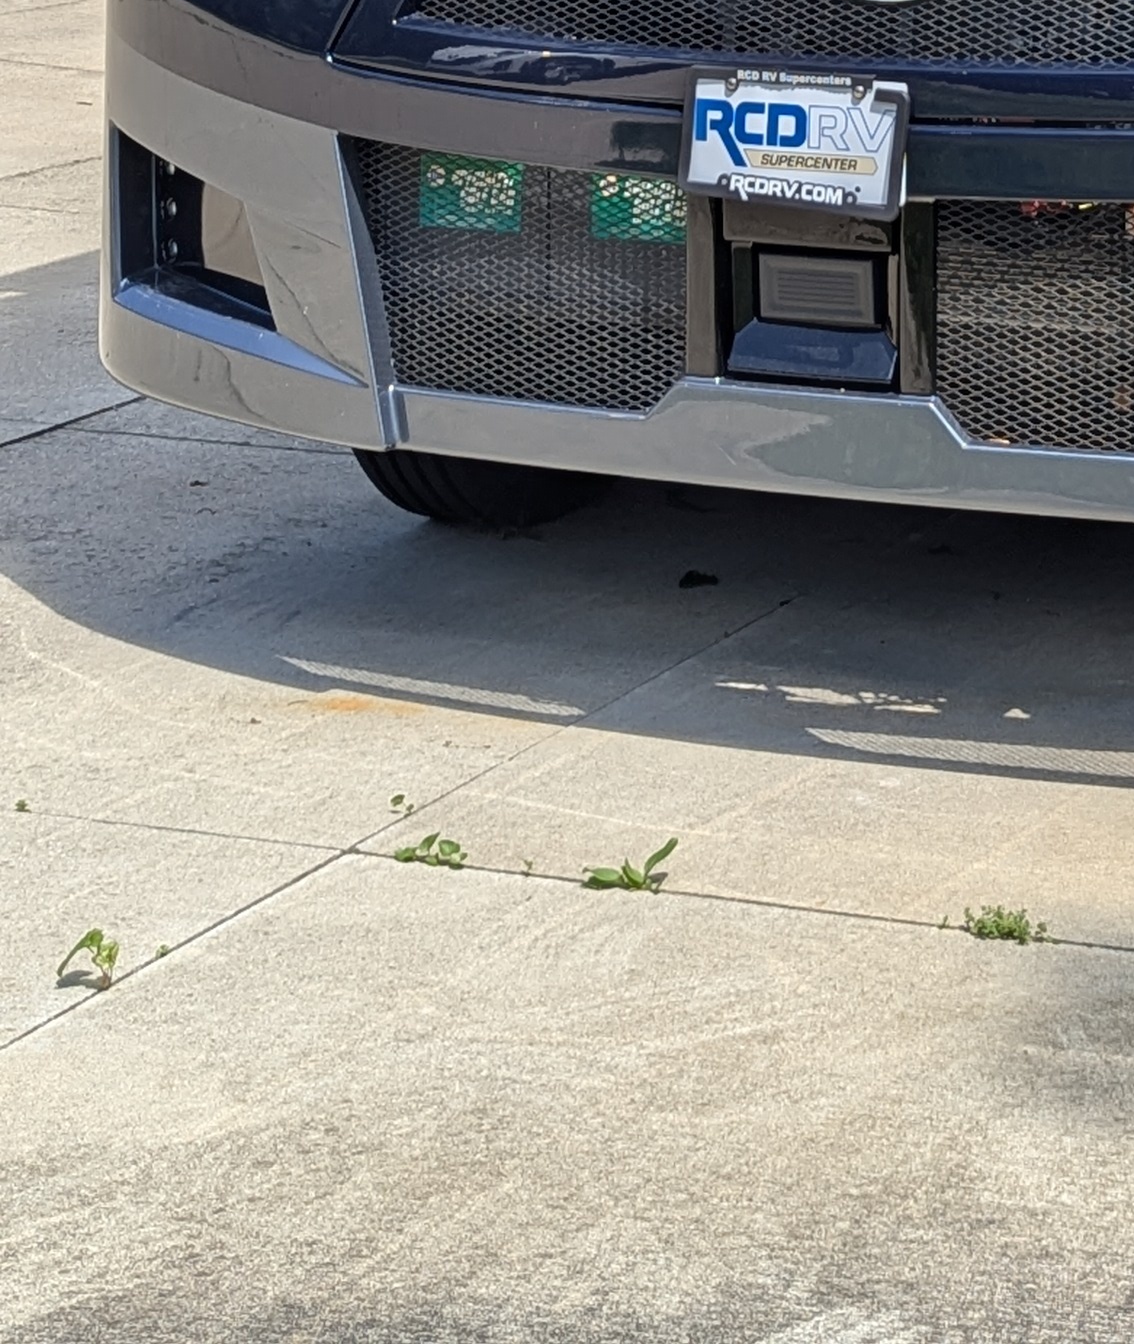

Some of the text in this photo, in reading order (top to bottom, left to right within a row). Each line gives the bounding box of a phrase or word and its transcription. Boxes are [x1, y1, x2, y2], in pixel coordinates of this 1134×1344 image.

[737, 69, 760, 81] RCD
[762, 71, 778, 83] RV
[760, 153, 858, 171] SUPERCENTER
[728, 174, 843, 206] RCDRV.COM
